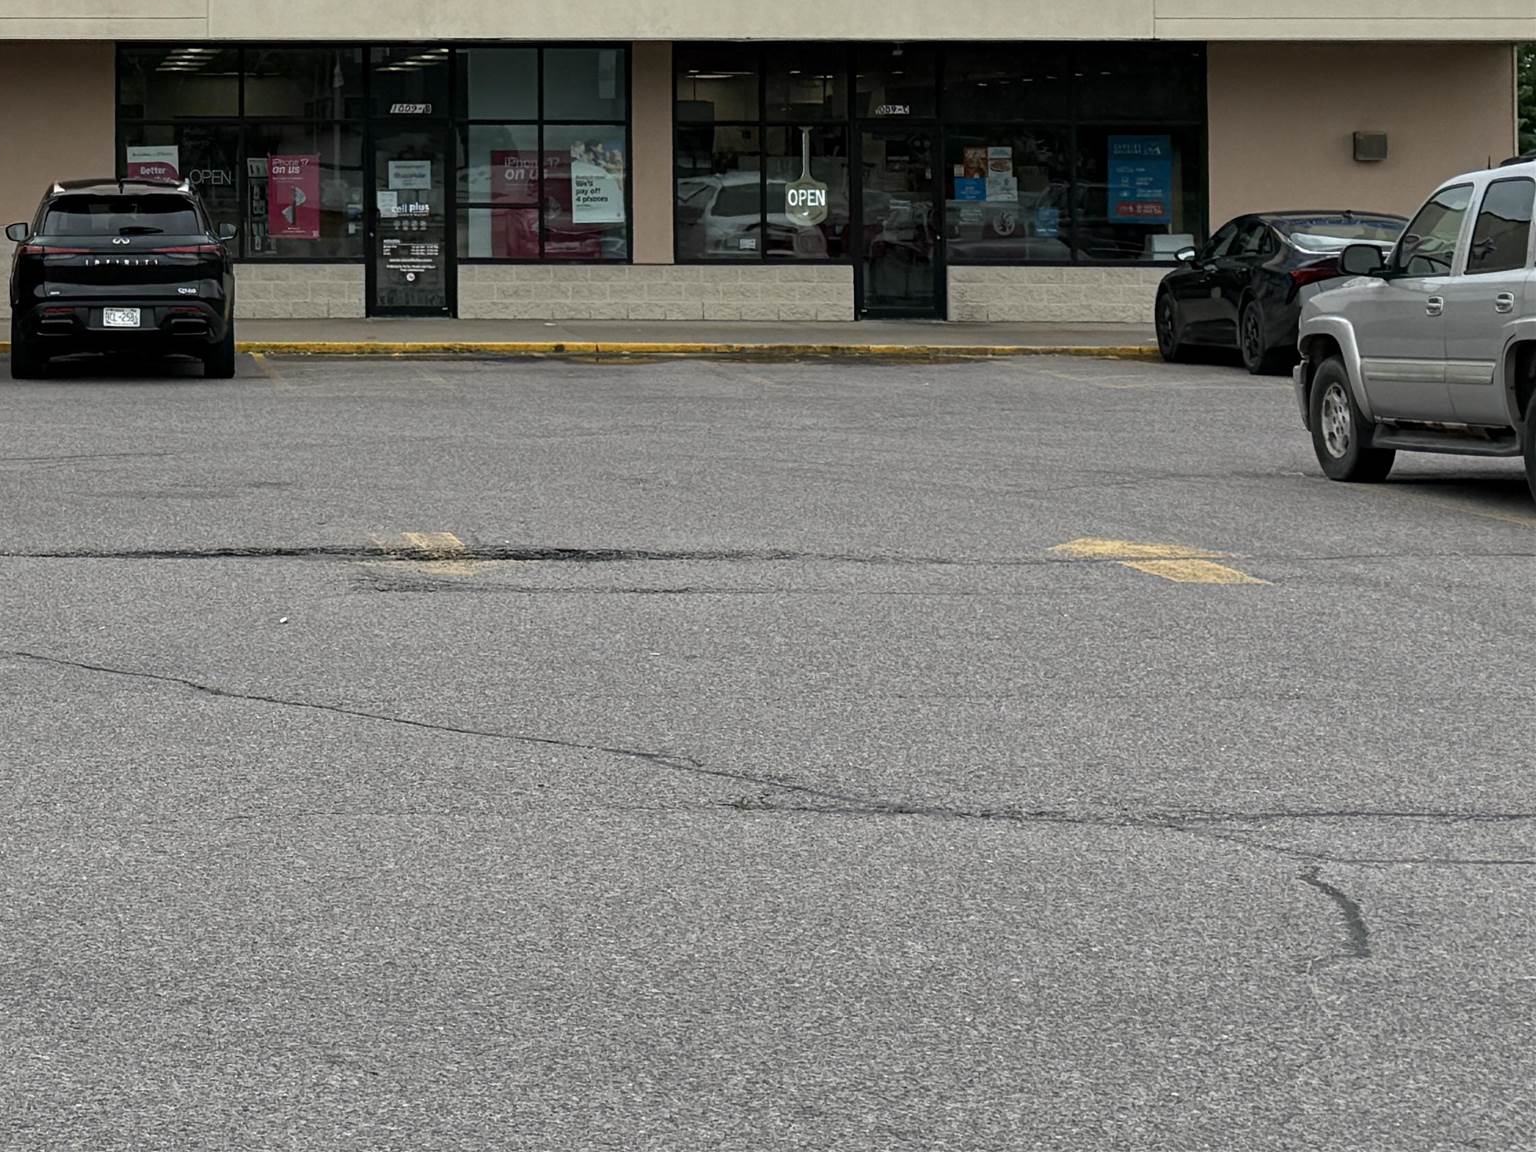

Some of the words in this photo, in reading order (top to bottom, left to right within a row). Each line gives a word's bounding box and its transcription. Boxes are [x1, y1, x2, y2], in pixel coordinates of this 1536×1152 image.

[140, 166, 167, 175] Better
[189, 168, 232, 185] OPEN
[272, 166, 285, 175] on
[288, 166, 300, 175] us
[504, 168, 525, 181] on
[787, 189, 826, 206] OPEN
[409, 201, 430, 213] plus
